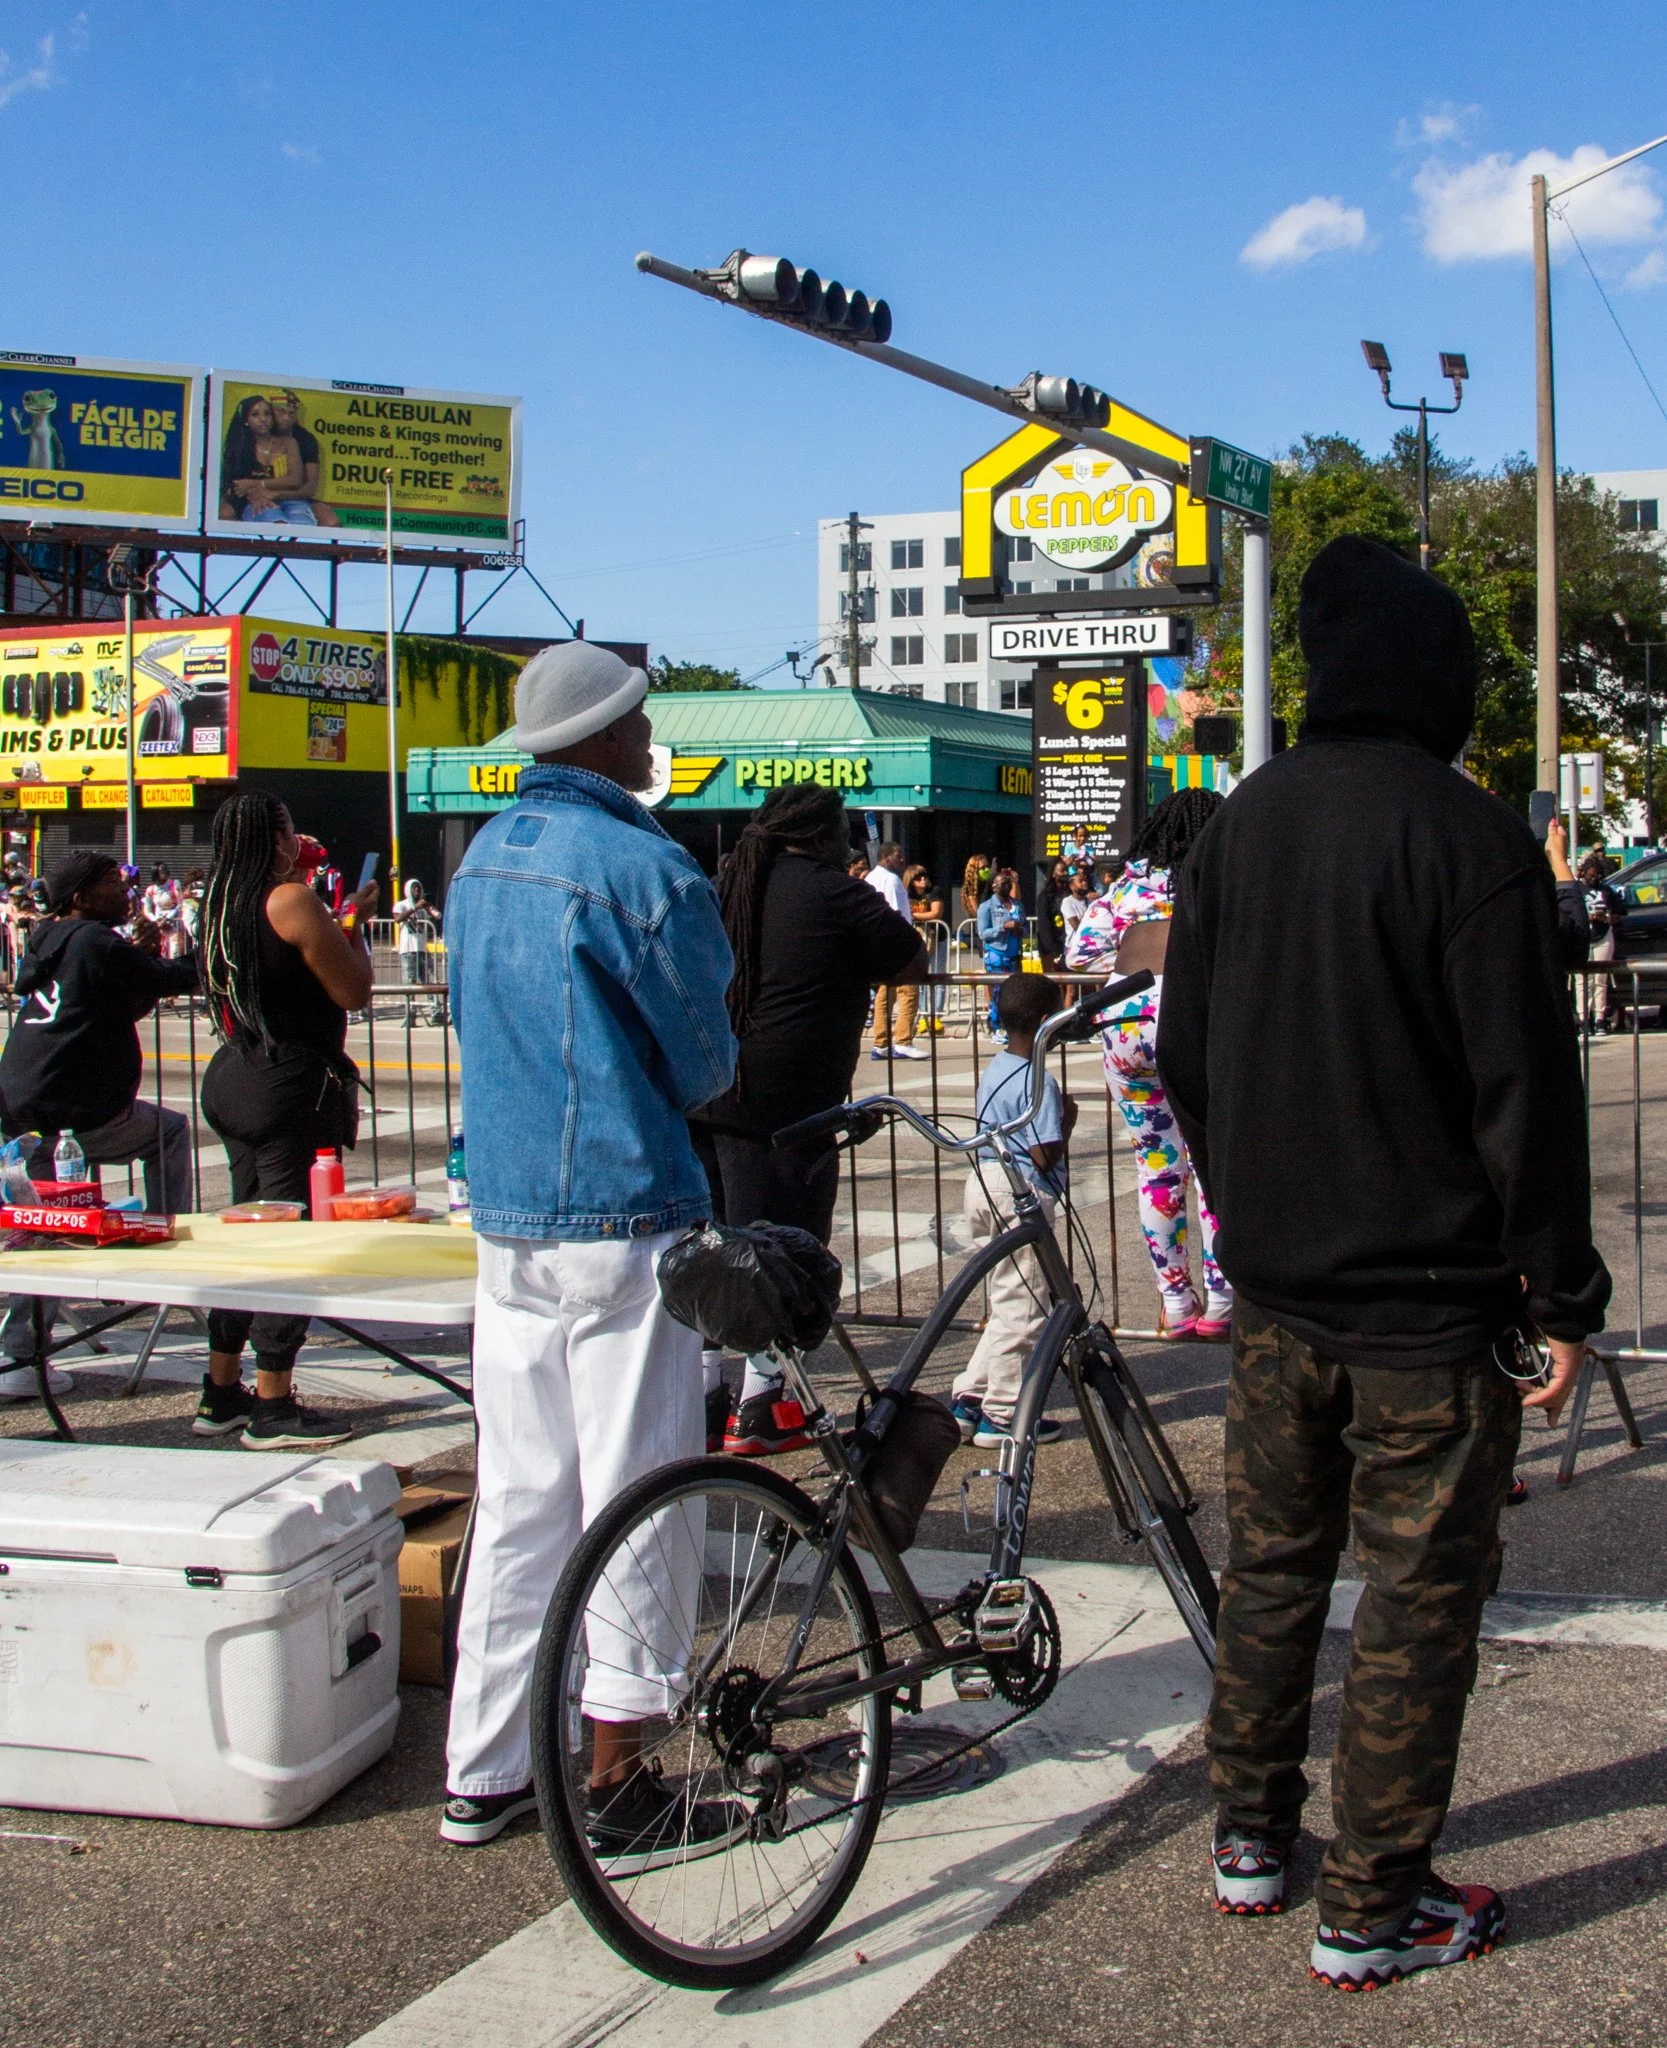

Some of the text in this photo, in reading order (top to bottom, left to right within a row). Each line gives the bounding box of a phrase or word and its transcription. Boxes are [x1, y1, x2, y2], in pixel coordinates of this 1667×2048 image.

[71, 400, 176, 431] FÁCIL DE
[347, 399, 473, 426] ALKEBULAN
[80, 425, 167, 451] ELEGIR
[314, 418, 503, 452] Queens & Kings moving
[1219, 449, 1263, 486] NW 27 AV
[332, 463, 454, 490] DRUG FREE
[396, 489, 449, 503] Recordings
[1009, 483, 1155, 529] LEMON
[346, 513, 506, 538] HosanaCommunityBC.org
[1047, 536, 1118, 555] PEPPERS
[482, 554, 523, 567] 006258
[1003, 624, 1157, 650] DRIVE THRU
[252, 646, 280, 666] STOP
[282, 637, 374, 670] 4 TIRES
[280, 663, 320, 684] ONLY
[271, 682, 284, 693] CALL
[310, 702, 345, 716] SPECIAL
[1053, 680, 1104, 730] $6
[0, 727, 129, 753] IMS & PLUS
[141, 741, 181, 753] ZEETEX
[1039, 735, 1127, 750] Lunch Special
[1063, 754, 1103, 763] PICK ONE
[736, 757, 867, 787] PEPPERS
[1045, 766, 1110, 777] 5 Legs & Thighs
[1045, 779, 1051, 787] 2
[1052, 778, 1079, 789] Wings
[1080, 778, 1087, 787] &
[1095, 778, 1126, 789] Shrimp
[22, 790, 65, 805] MUFFLER
[85, 790, 128, 804] OIL CHANGE
[145, 788, 191, 803] CATALITICO
[1045, 790, 1075, 800] Tilapia
[1075, 790, 1082, 798] &
[1090, 789, 1121, 800] Shrimp
[1045, 801, 1075, 810] Catfish
[1075, 801, 1083, 810] &
[1090, 801, 1121, 812] Shrimp
[1052, 813, 1088, 822] Boneless
[1088, 813, 1116, 823] Wings
[71, 1191, 94, 1205] PCS
[13, 1211, 87, 1228] 30x20 PCS
